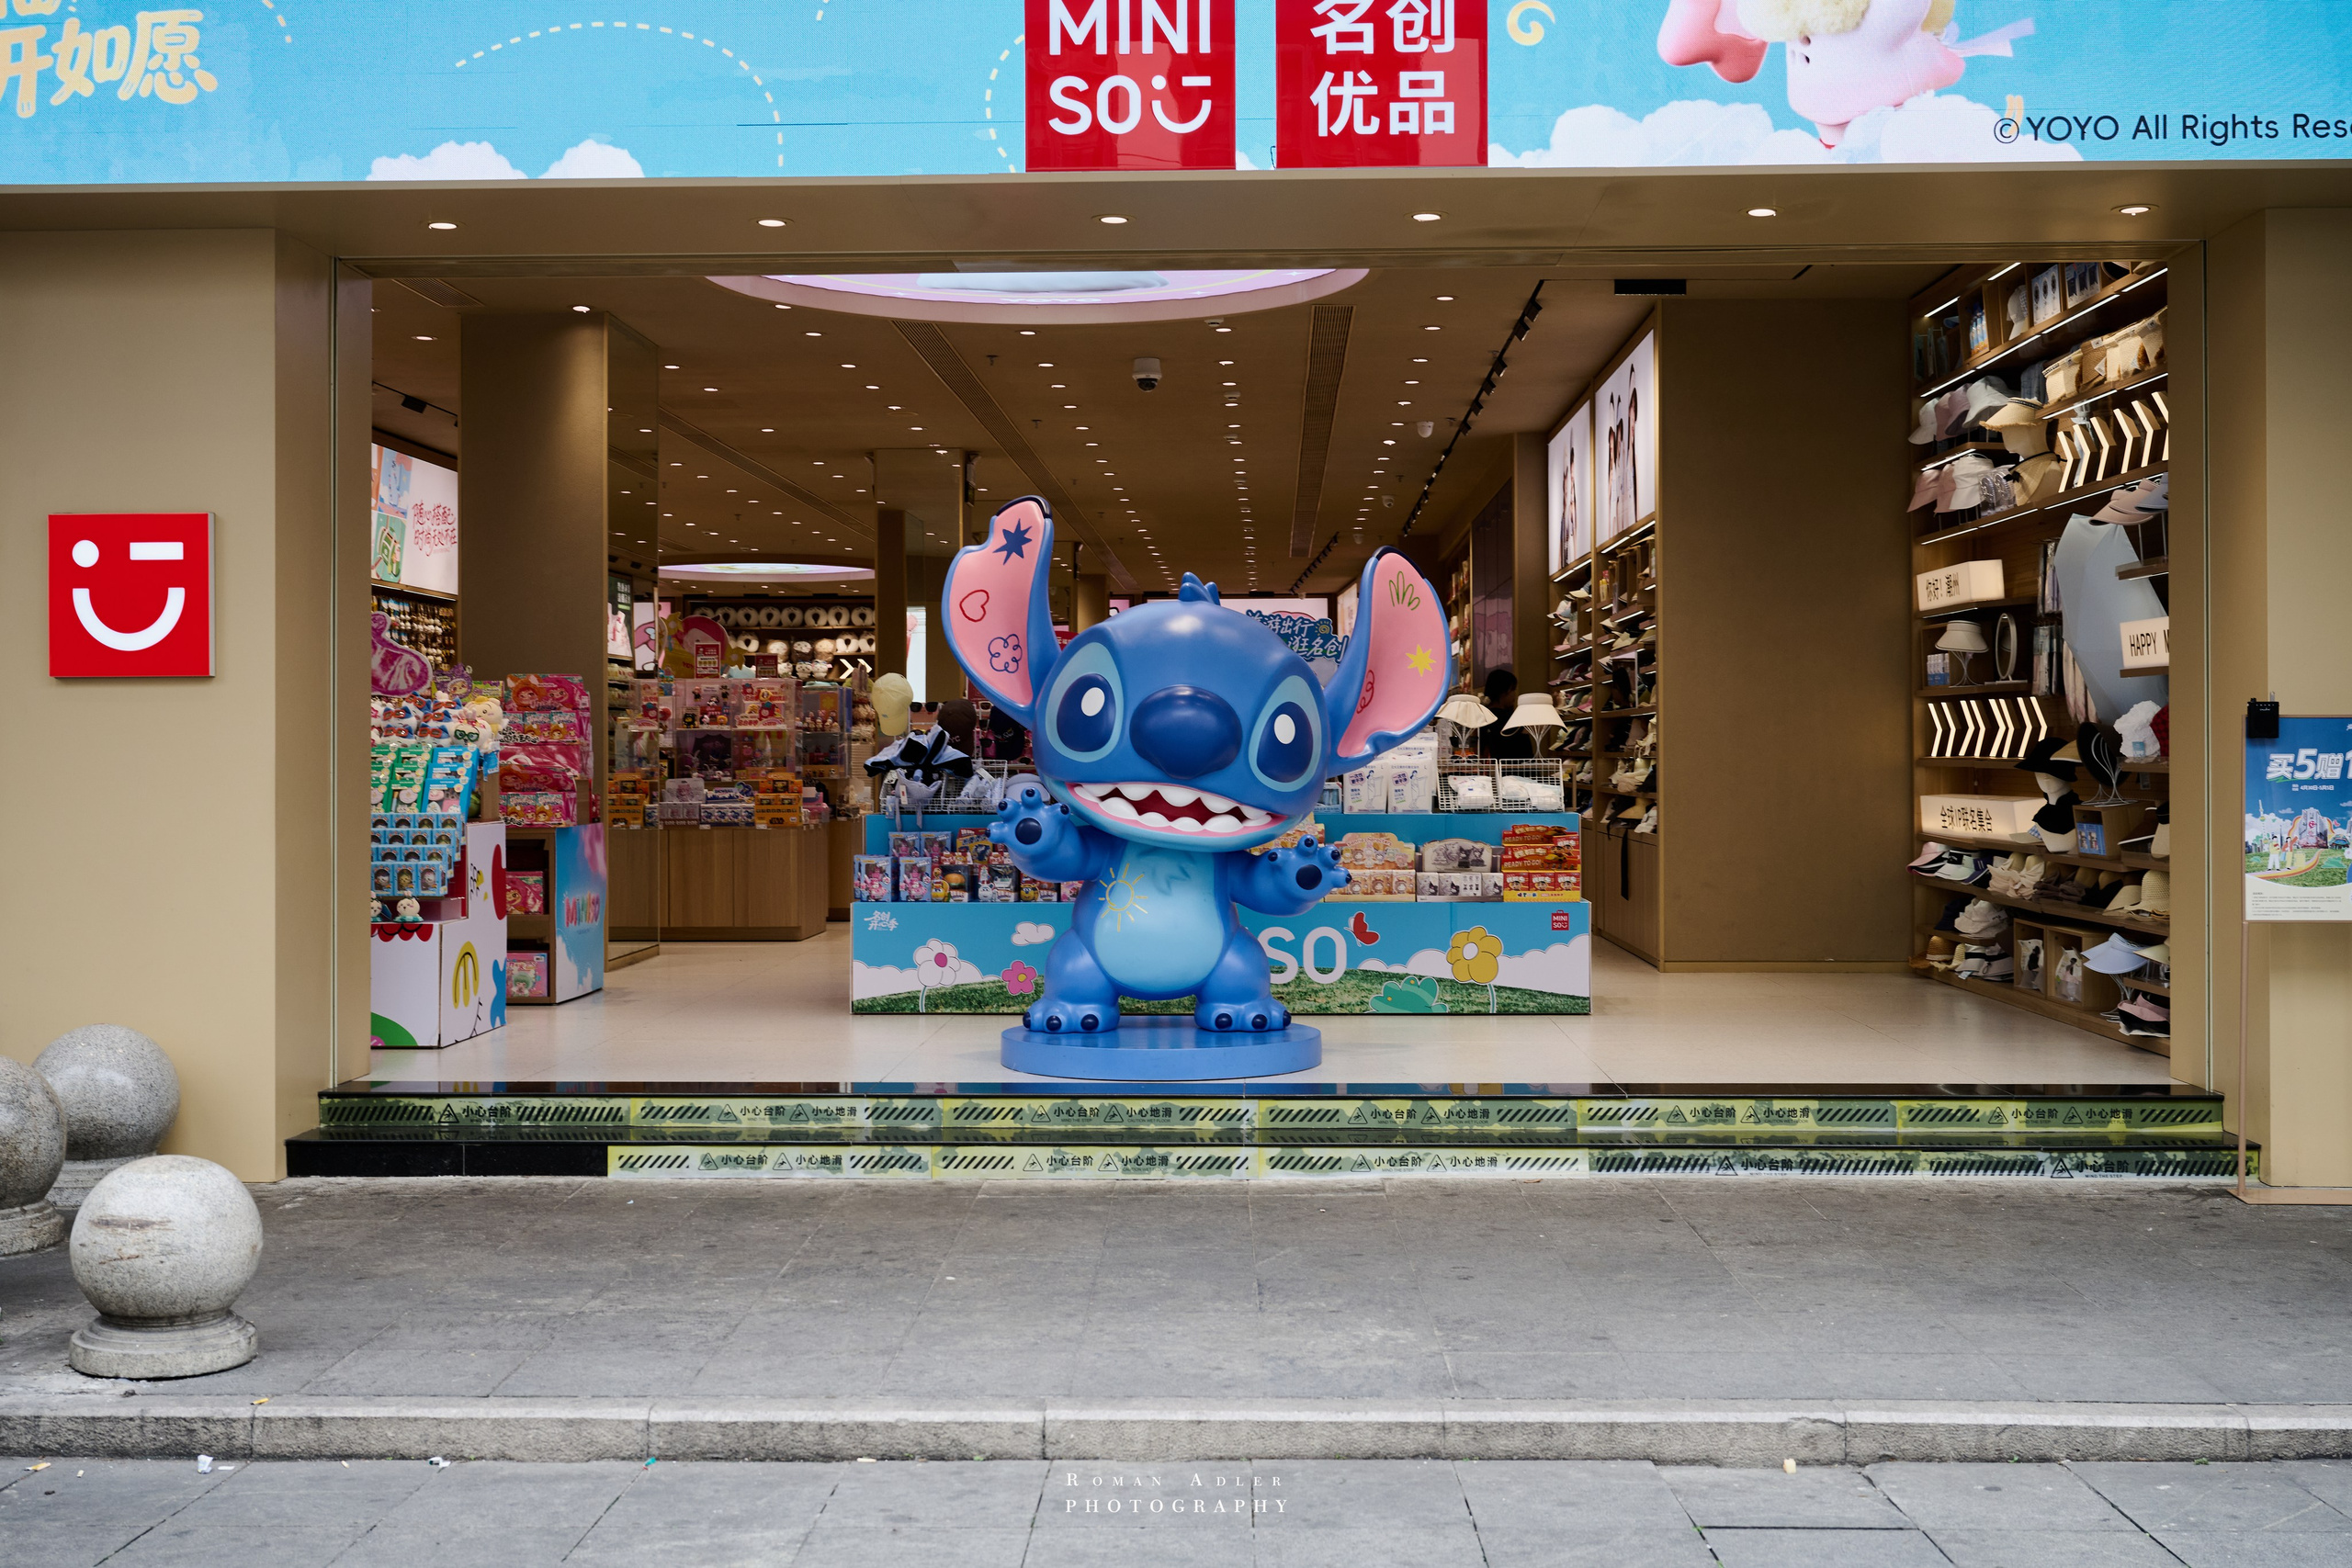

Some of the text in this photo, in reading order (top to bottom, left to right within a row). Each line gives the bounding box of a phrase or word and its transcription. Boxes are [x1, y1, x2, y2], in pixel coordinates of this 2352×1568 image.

[1049, 0, 1211, 55] MINI
[1310, 0, 1455, 54] 名创
[1310, 71, 1455, 136] 优品
[2132, 114, 2167, 141] All
[2182, 113, 2279, 146] Rights
[2292, 114, 2352, 140] Res
[1287, 636, 1349, 662] 逛名创
[2129, 631, 2157, 657] HAPPY
[462, 1105, 512, 1118] 小心台阶
[740, 1106, 786, 1117] 小心台阶
[811, 1106, 857, 1117] 小心地滑
[1054, 1107, 1100, 1118] 小心台阶
[1126, 1107, 1172, 1118] 小心地滑
[1371, 1108, 1417, 1120] 小心台阶
[1444, 1108, 1490, 1120] 小心地滑
[1690, 1107, 1736, 1118] 小心台阶
[1763, 1107, 1810, 1118] 小心地滑
[2012, 1108, 2058, 1119] 小心台阶
[2086, 1108, 2132, 1119] 小心地滑
[721, 1155, 768, 1166] 小心台阶
[796, 1155, 842, 1166] 小心地滑
[1046, 1155, 1093, 1167] 小心台阶
[1122, 1155, 1169, 1167] 小心地滑
[1374, 1156, 1422, 1168] 小心台阶
[1450, 1156, 1498, 1168] 小心地滑
[1741, 1157, 1793, 1171] 小心台阶
[2076, 1159, 2130, 1173] 小心台阶
